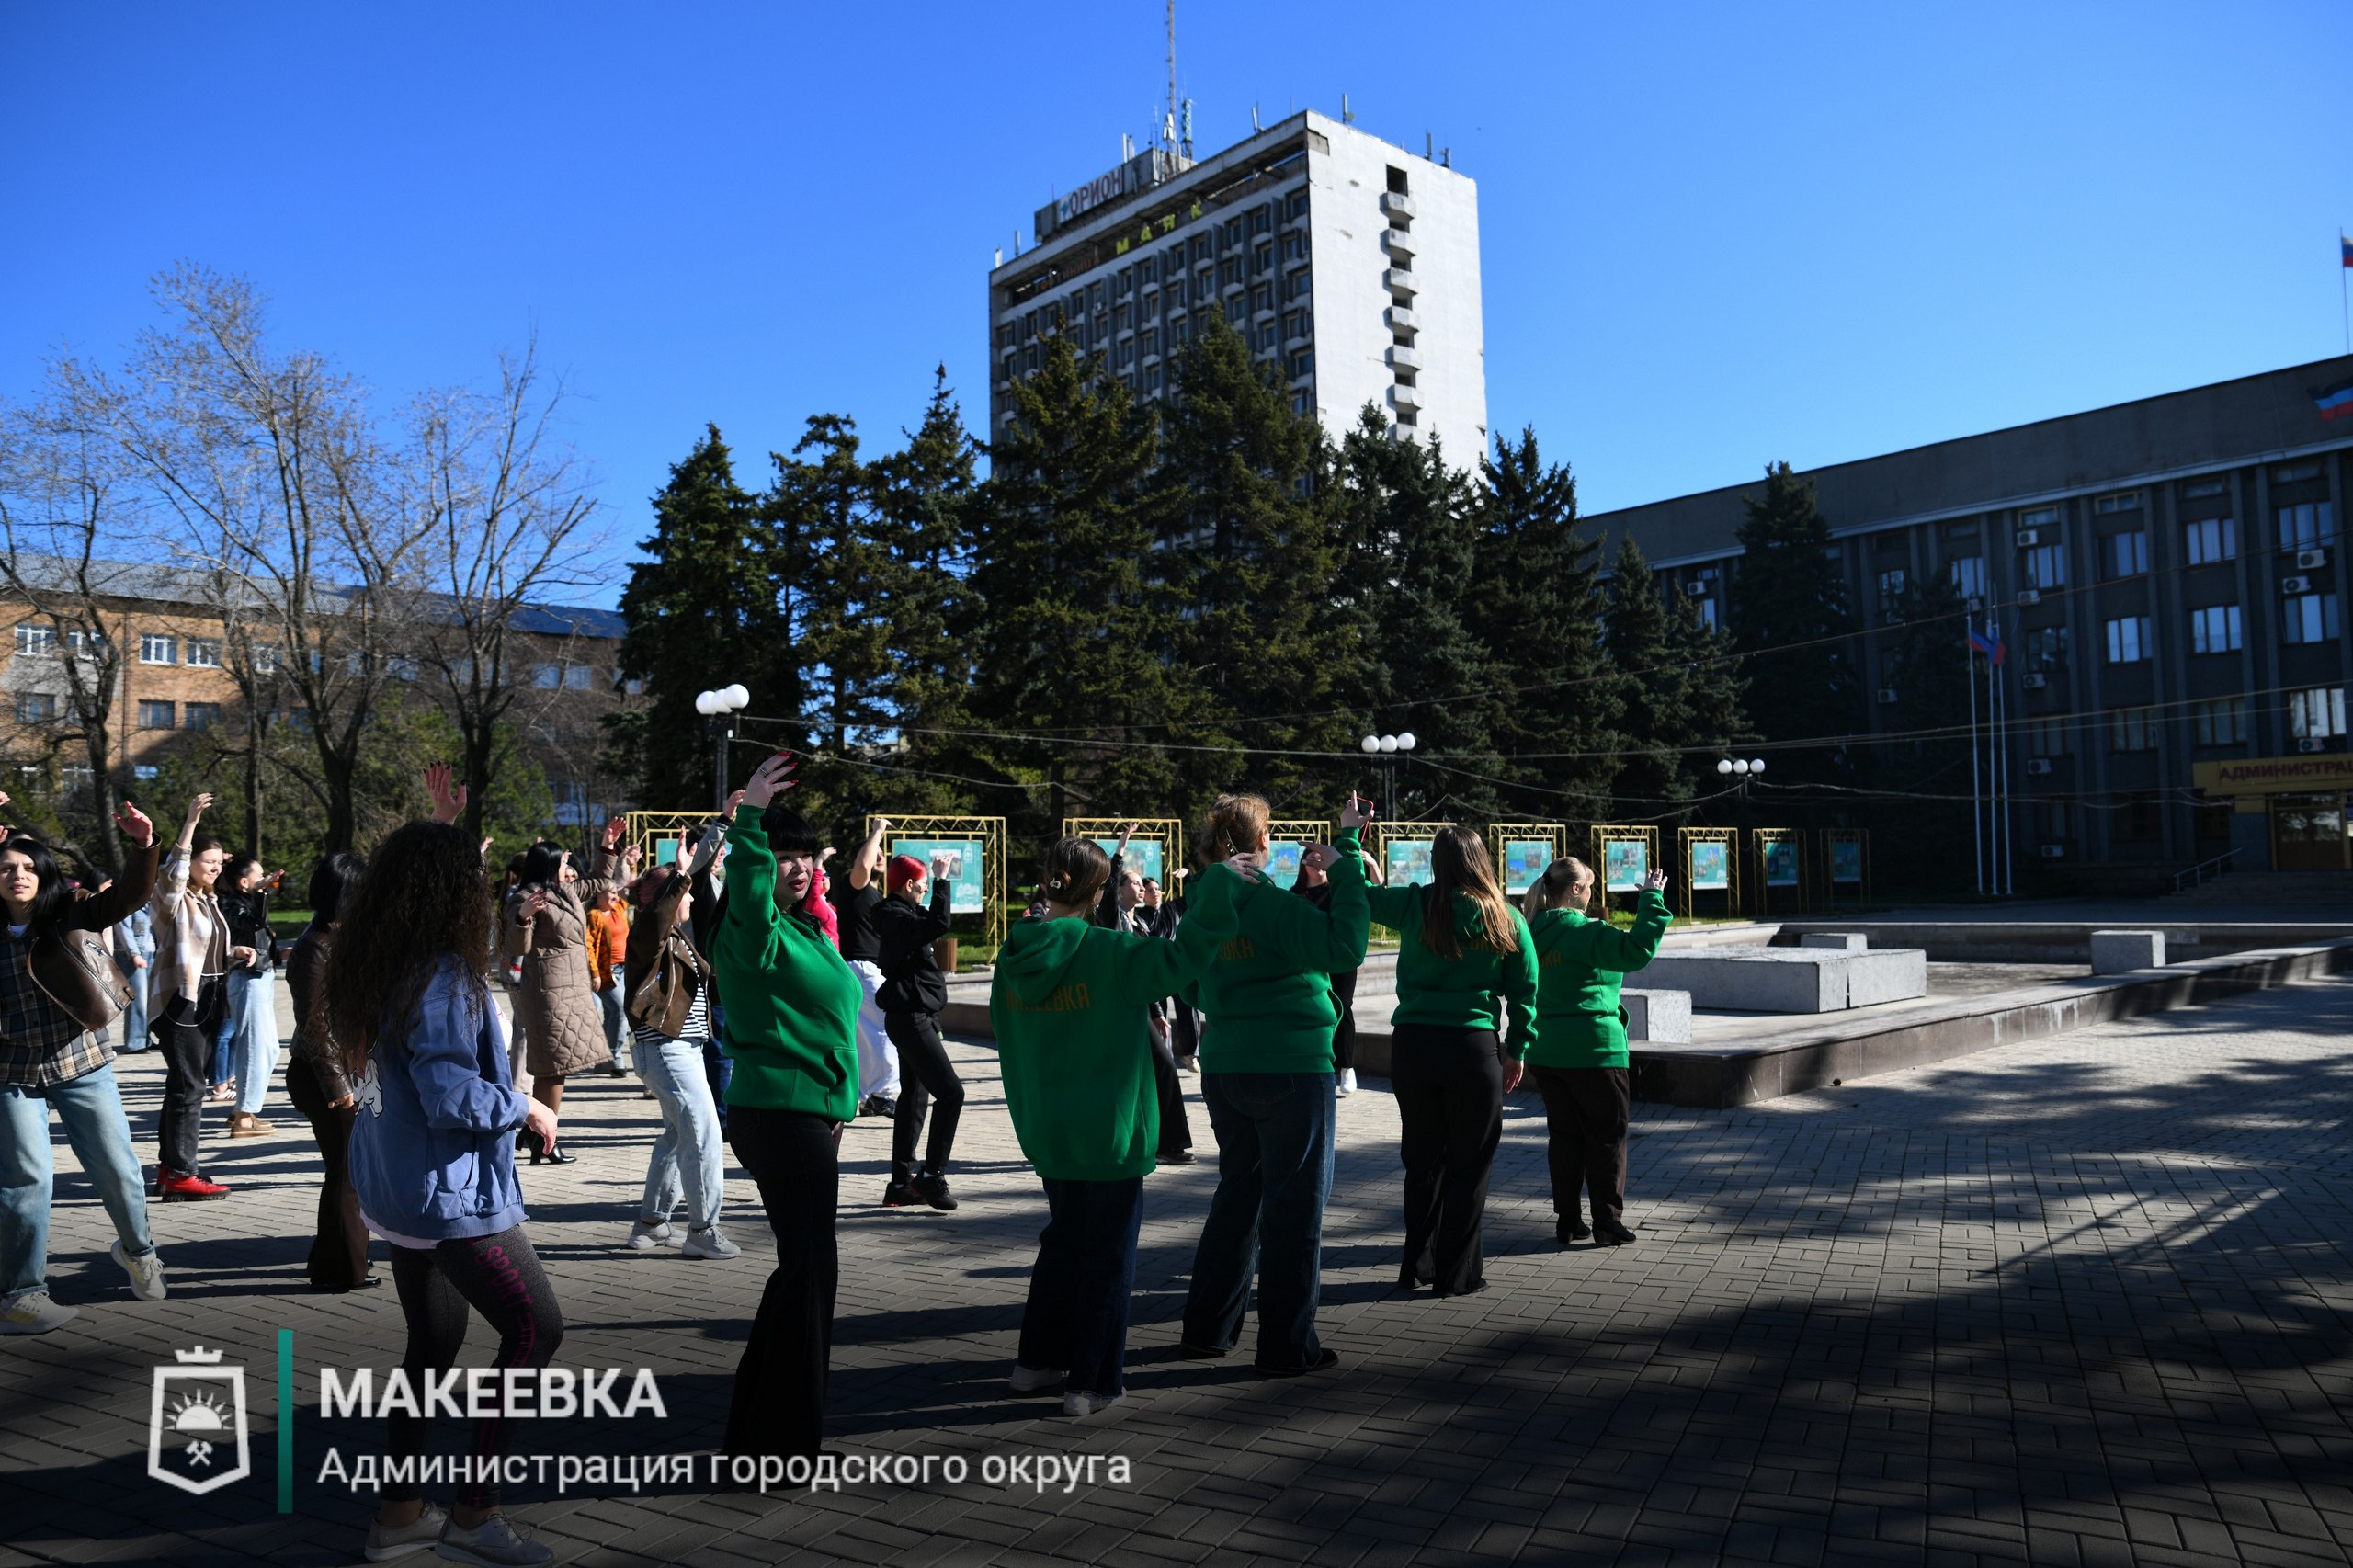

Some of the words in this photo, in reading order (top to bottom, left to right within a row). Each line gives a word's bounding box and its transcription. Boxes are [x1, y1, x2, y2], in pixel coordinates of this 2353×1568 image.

[1069, 167, 1120, 216] ОРИОН
[1115, 200, 1204, 255] МАЯК
[472, 1244, 534, 1309] SPORT
